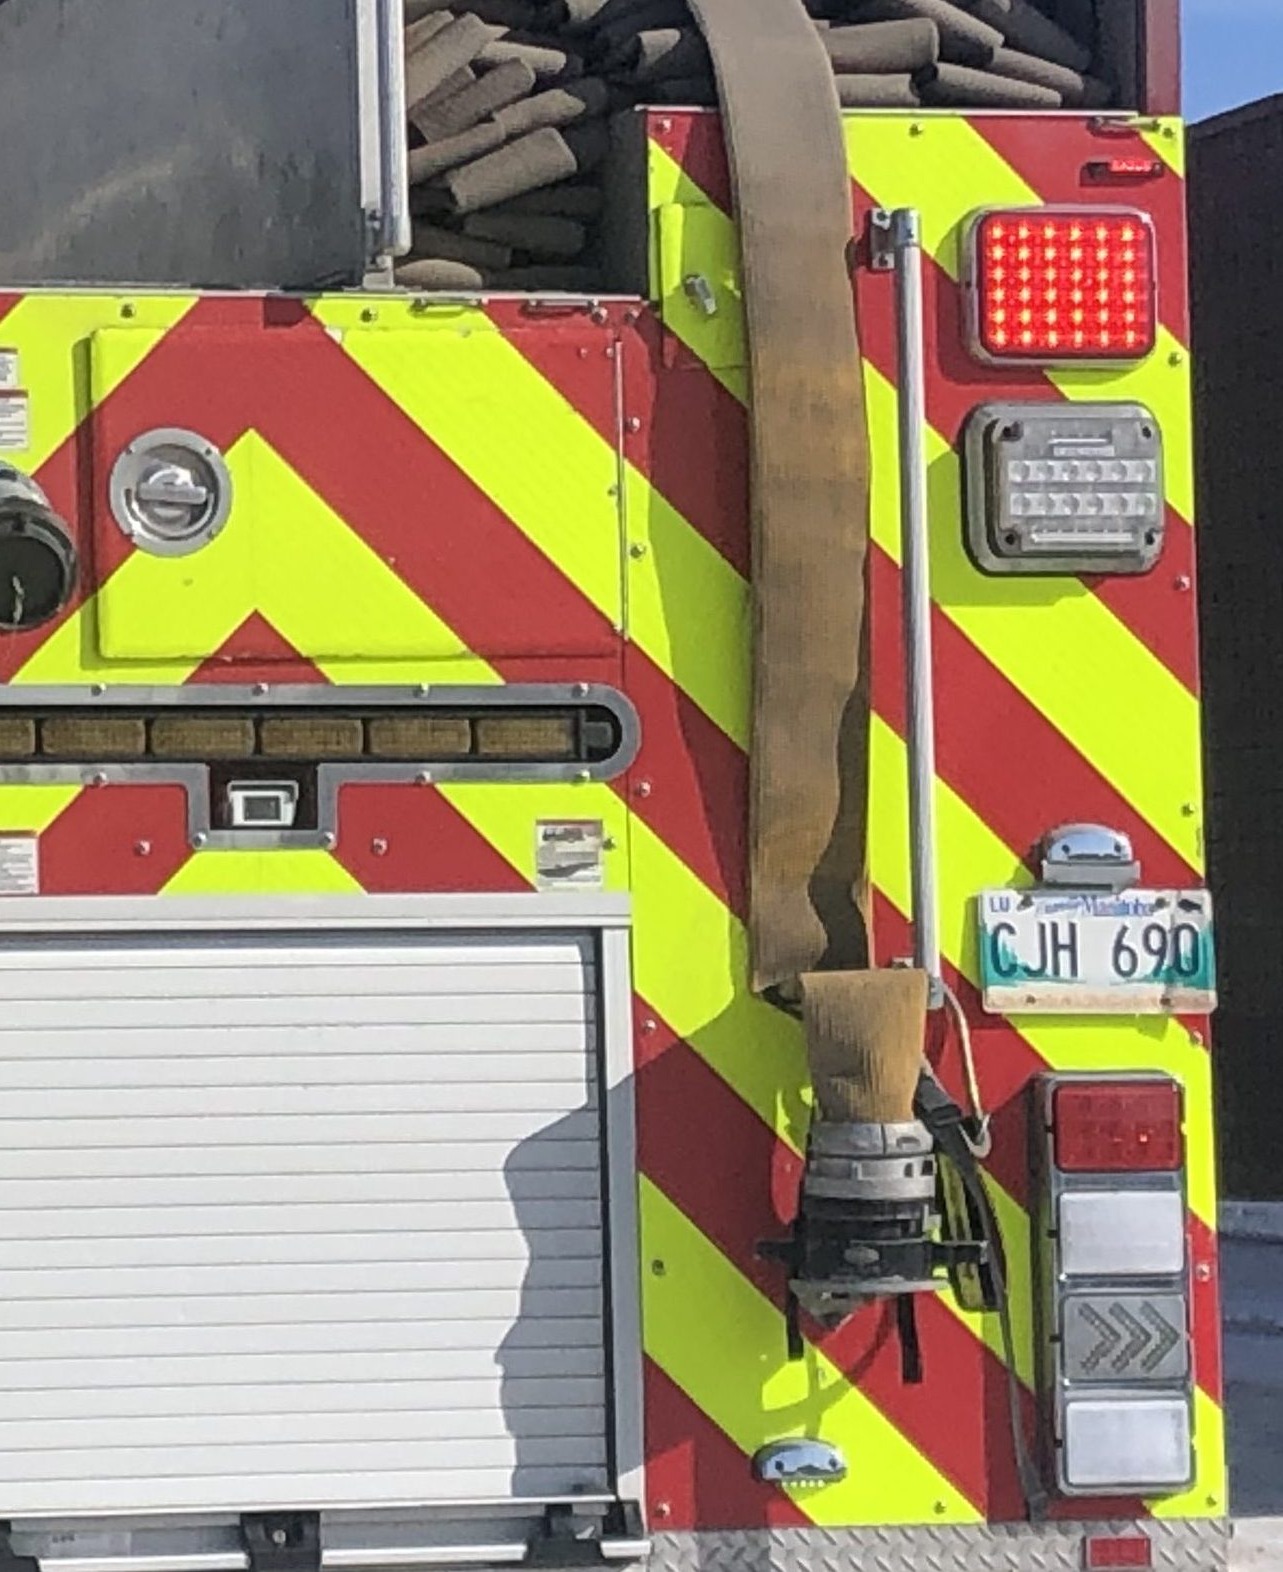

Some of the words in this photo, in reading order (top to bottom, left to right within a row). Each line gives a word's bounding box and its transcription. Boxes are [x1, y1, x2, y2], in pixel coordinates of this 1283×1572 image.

[990, 897, 1010, 913] LU
[991, 921, 1079, 978] CJH
[1112, 922, 1200, 978] 690
